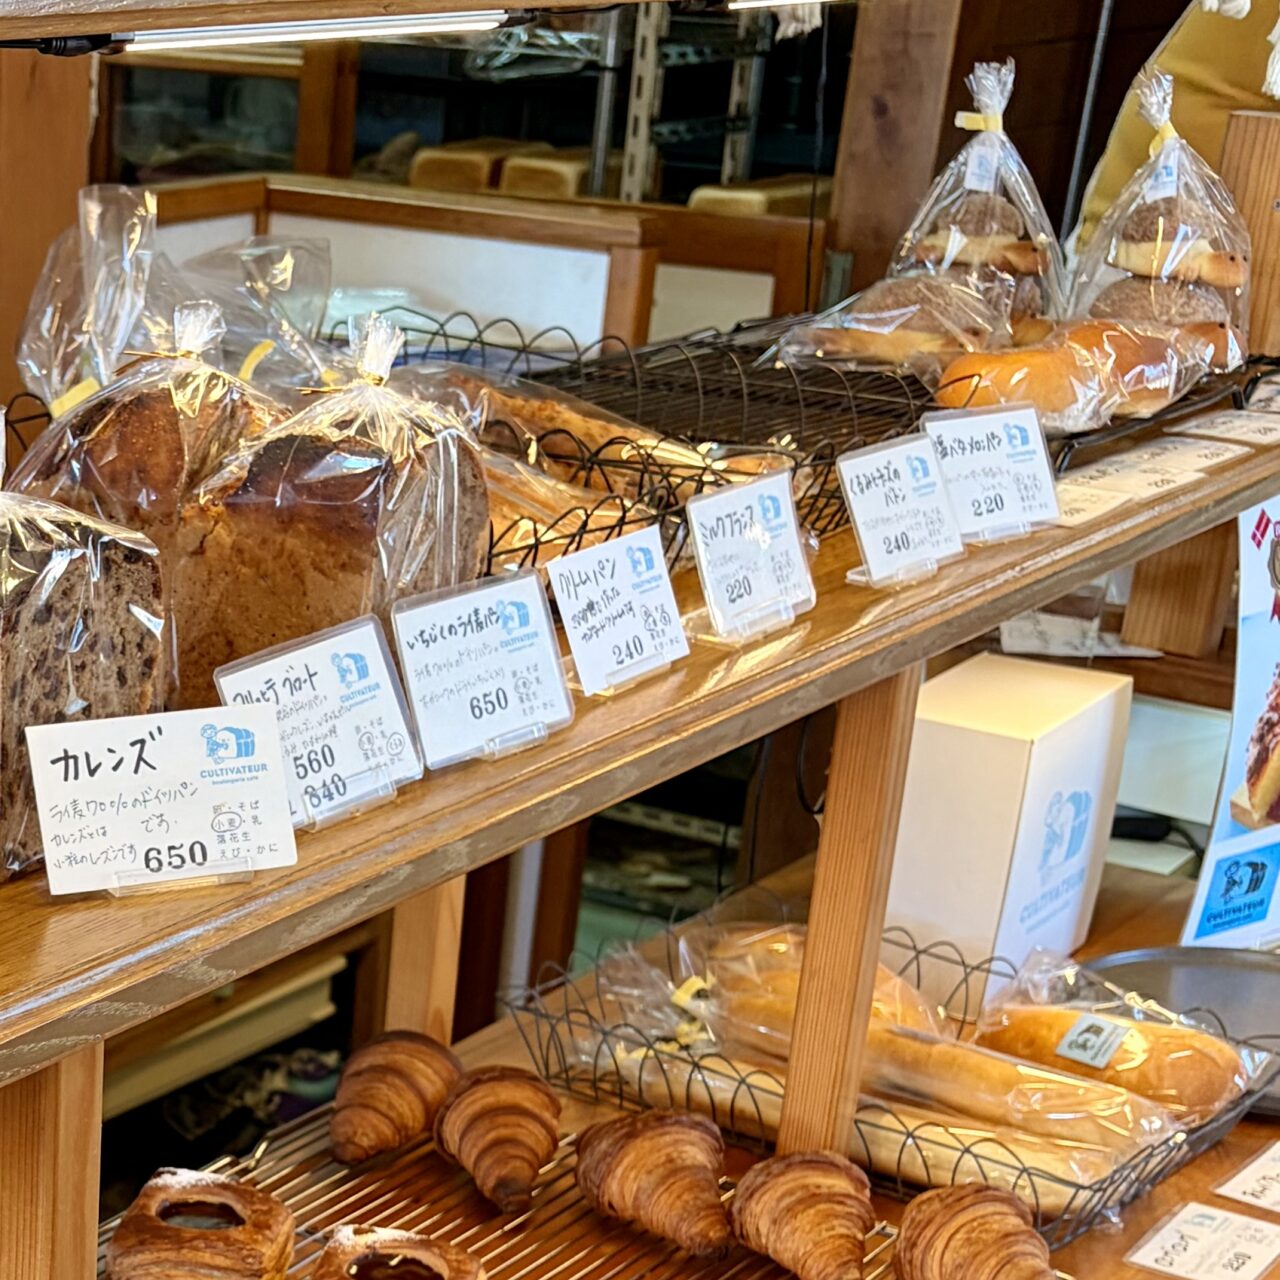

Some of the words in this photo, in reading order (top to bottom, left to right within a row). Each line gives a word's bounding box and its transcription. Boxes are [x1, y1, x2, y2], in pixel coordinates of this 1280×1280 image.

[971, 493, 1005, 517] 220
[883, 531, 911, 555] 240
[725, 575, 752, 604] 220
[612, 635, 644, 665] 240
[469, 687, 509, 720] 650
[50, 726, 163, 782] カレンズ
[293, 744, 335, 780] 560
[199, 763, 268, 779] CULTIVATEUR
[304, 773, 347, 809] 840
[216, 831, 251, 845] 落花生
[220, 843, 279, 861] えび・かに
[144, 840, 208, 873] 650
